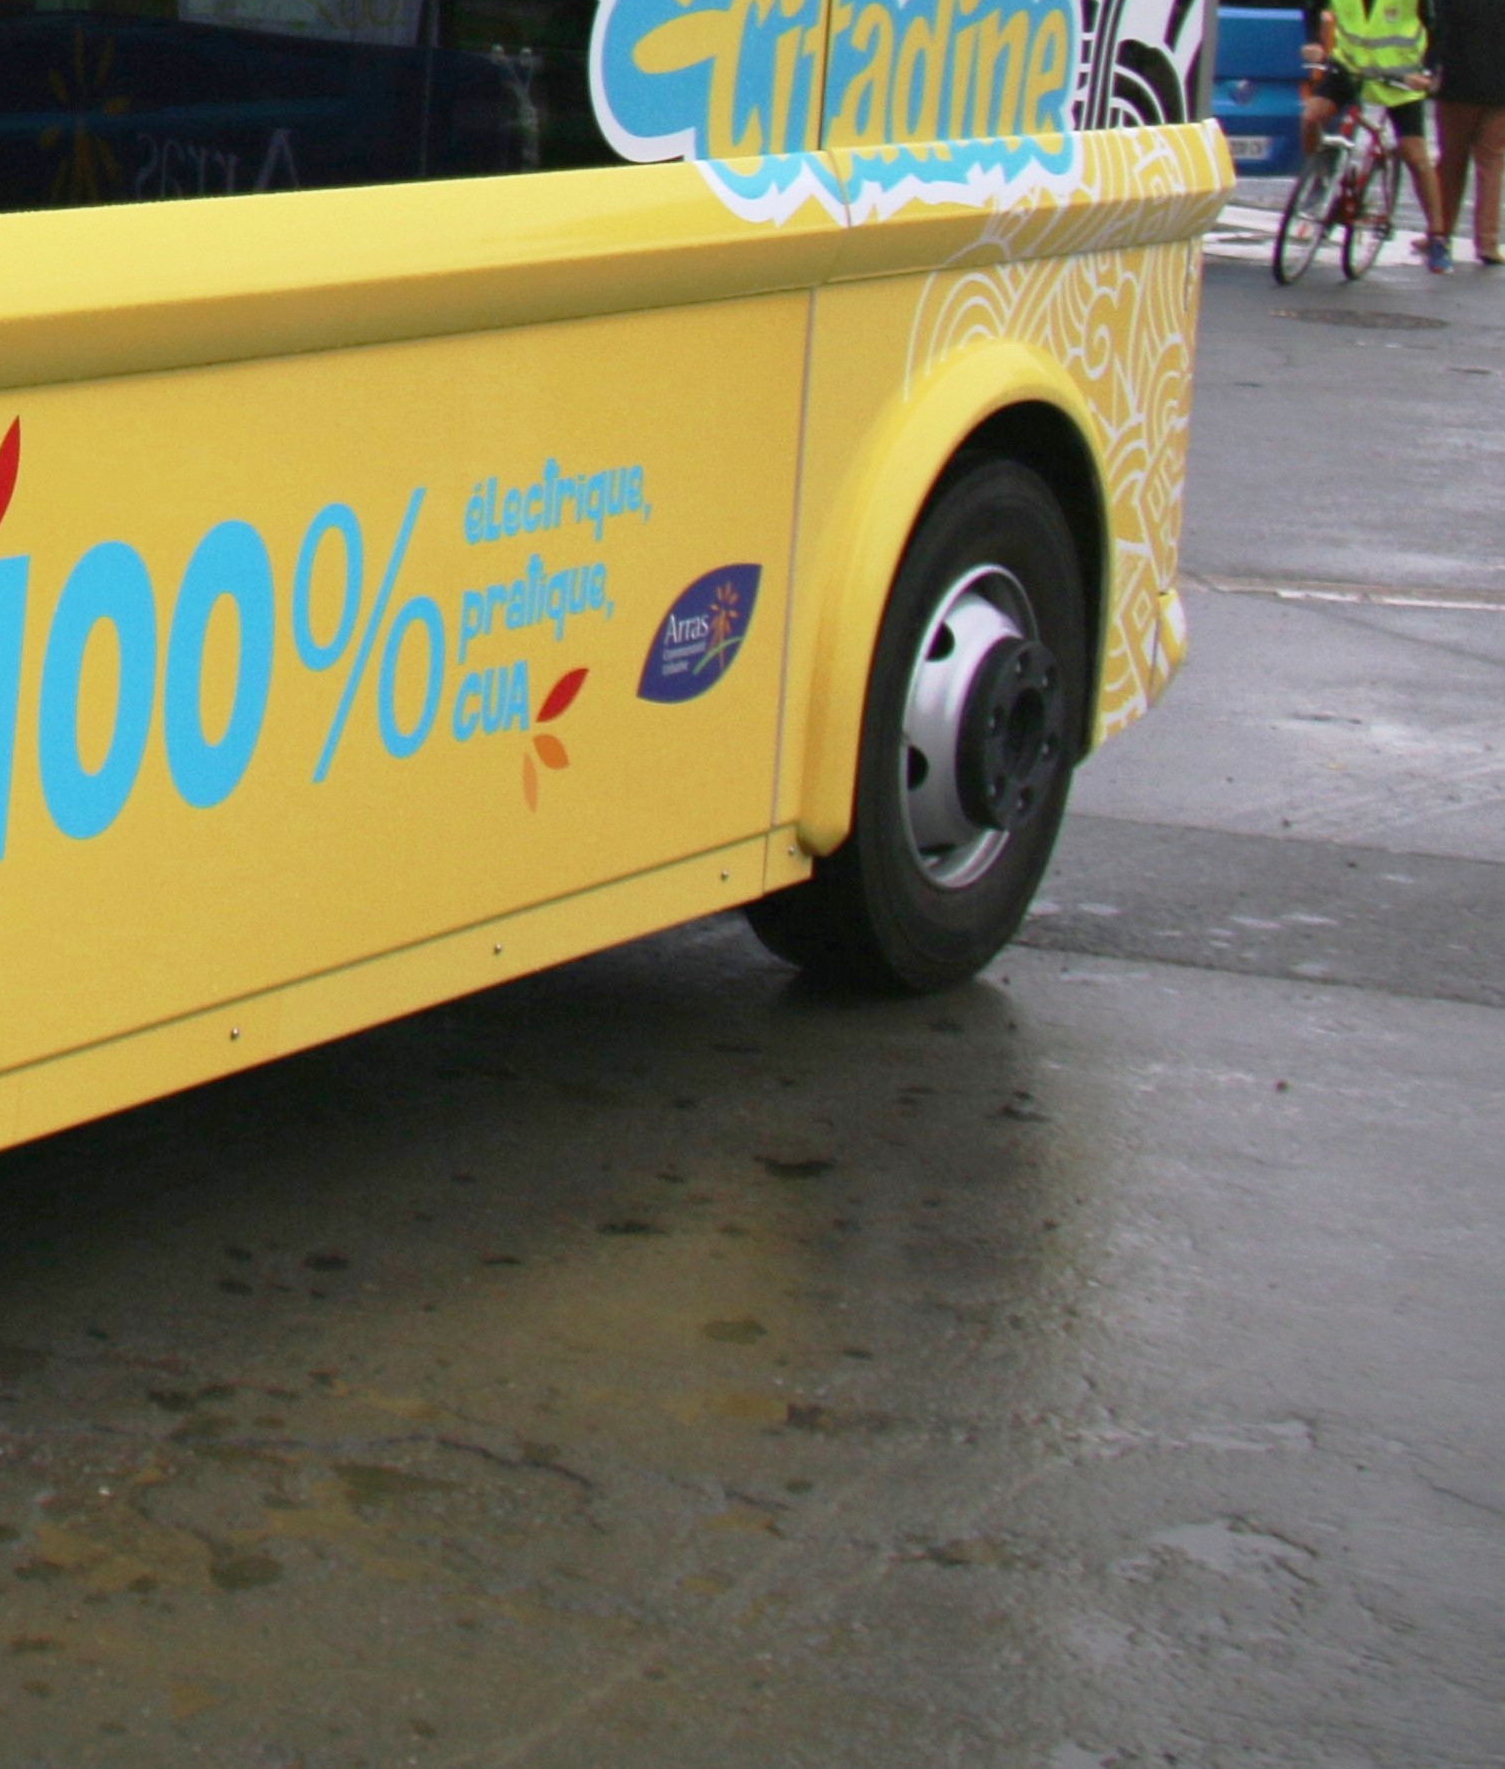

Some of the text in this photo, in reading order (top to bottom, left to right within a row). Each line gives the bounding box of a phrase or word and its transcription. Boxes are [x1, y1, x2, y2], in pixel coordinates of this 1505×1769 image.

[458, 553, 616, 665] pratique,
[663, 613, 710, 647] Arras
[452, 659, 531, 743] CUA
